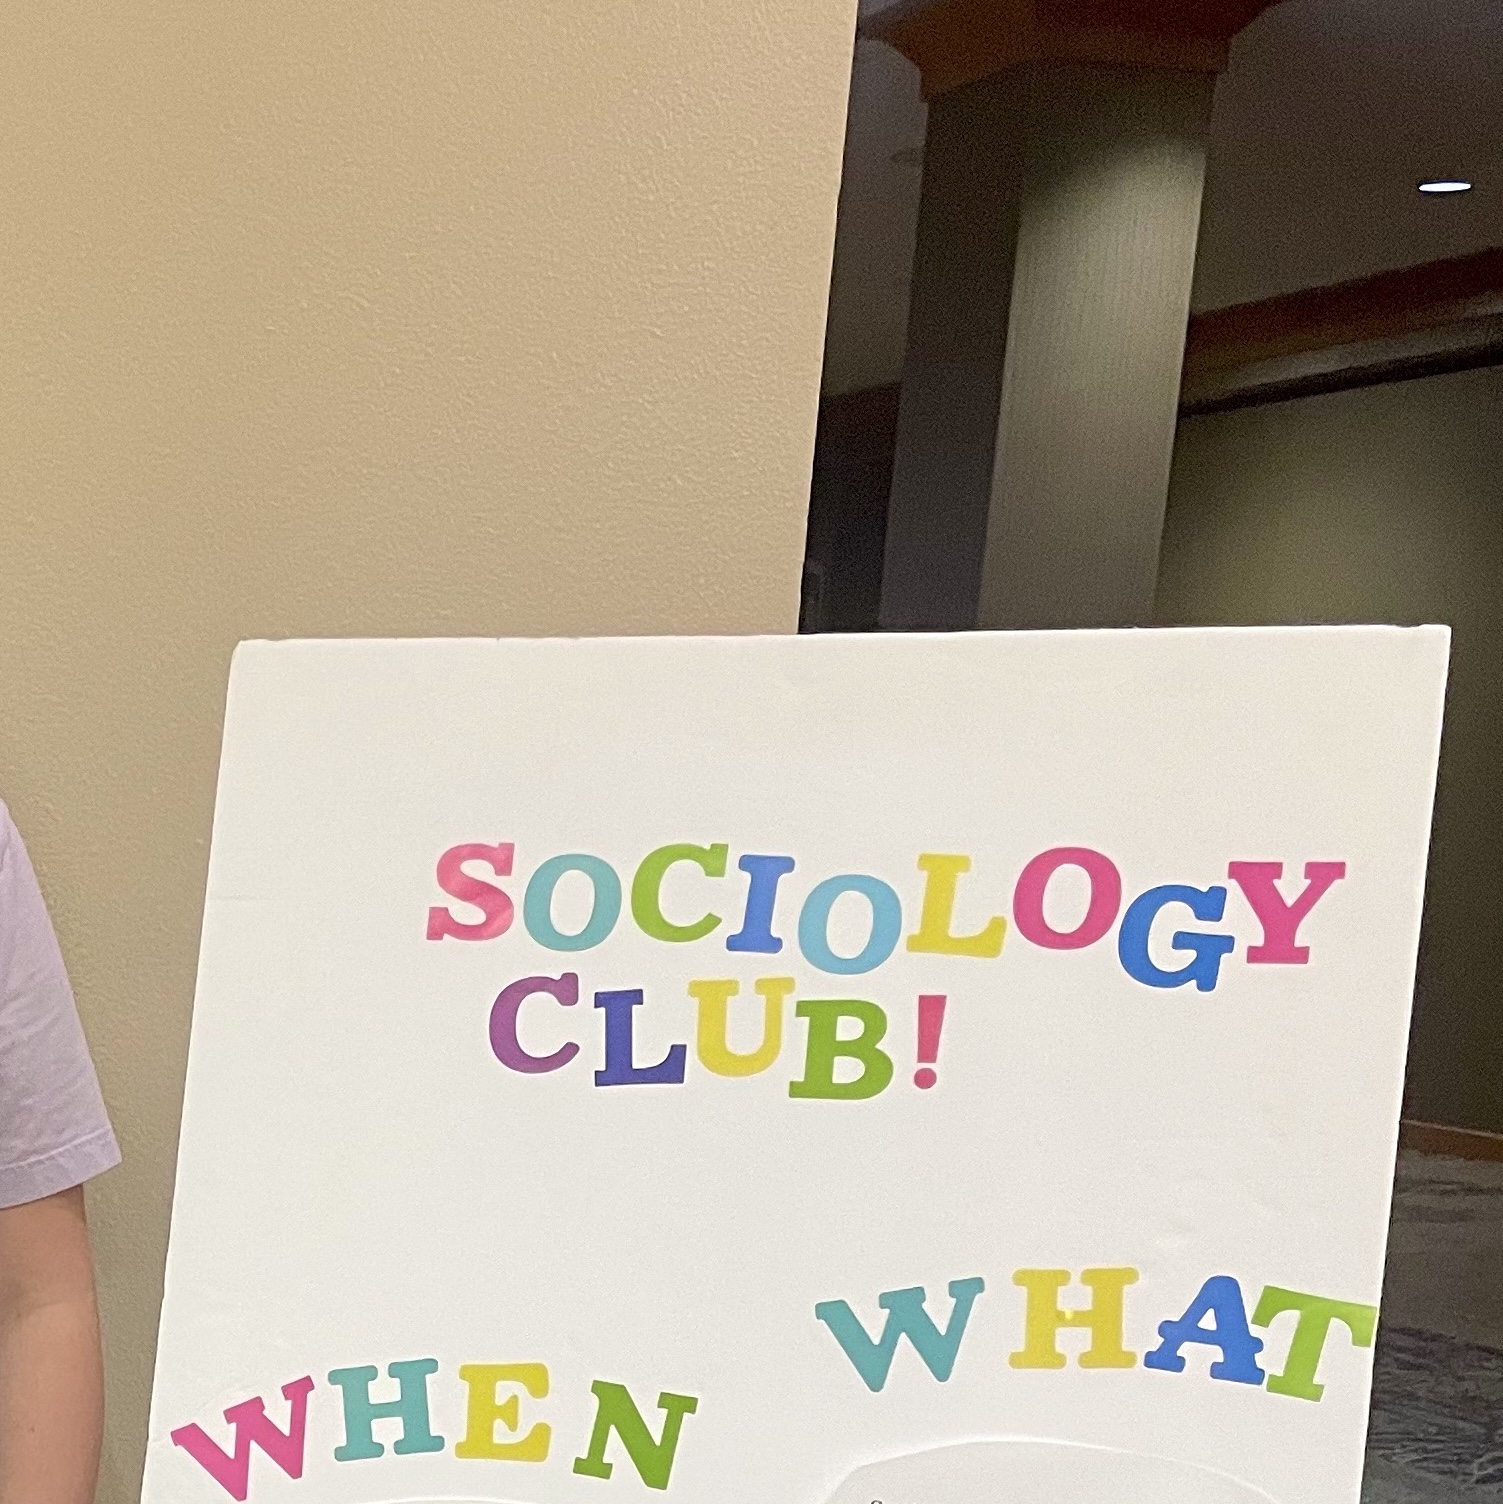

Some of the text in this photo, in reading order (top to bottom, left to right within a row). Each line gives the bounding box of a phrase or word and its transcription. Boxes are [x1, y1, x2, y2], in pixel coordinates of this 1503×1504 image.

[426, 842, 1346, 992] SOCIOLOGY
[488, 971, 947, 1101] CLUB!
[814, 1267, 1378, 1403] WHAT
[170, 1357, 699, 1503] WHEN
